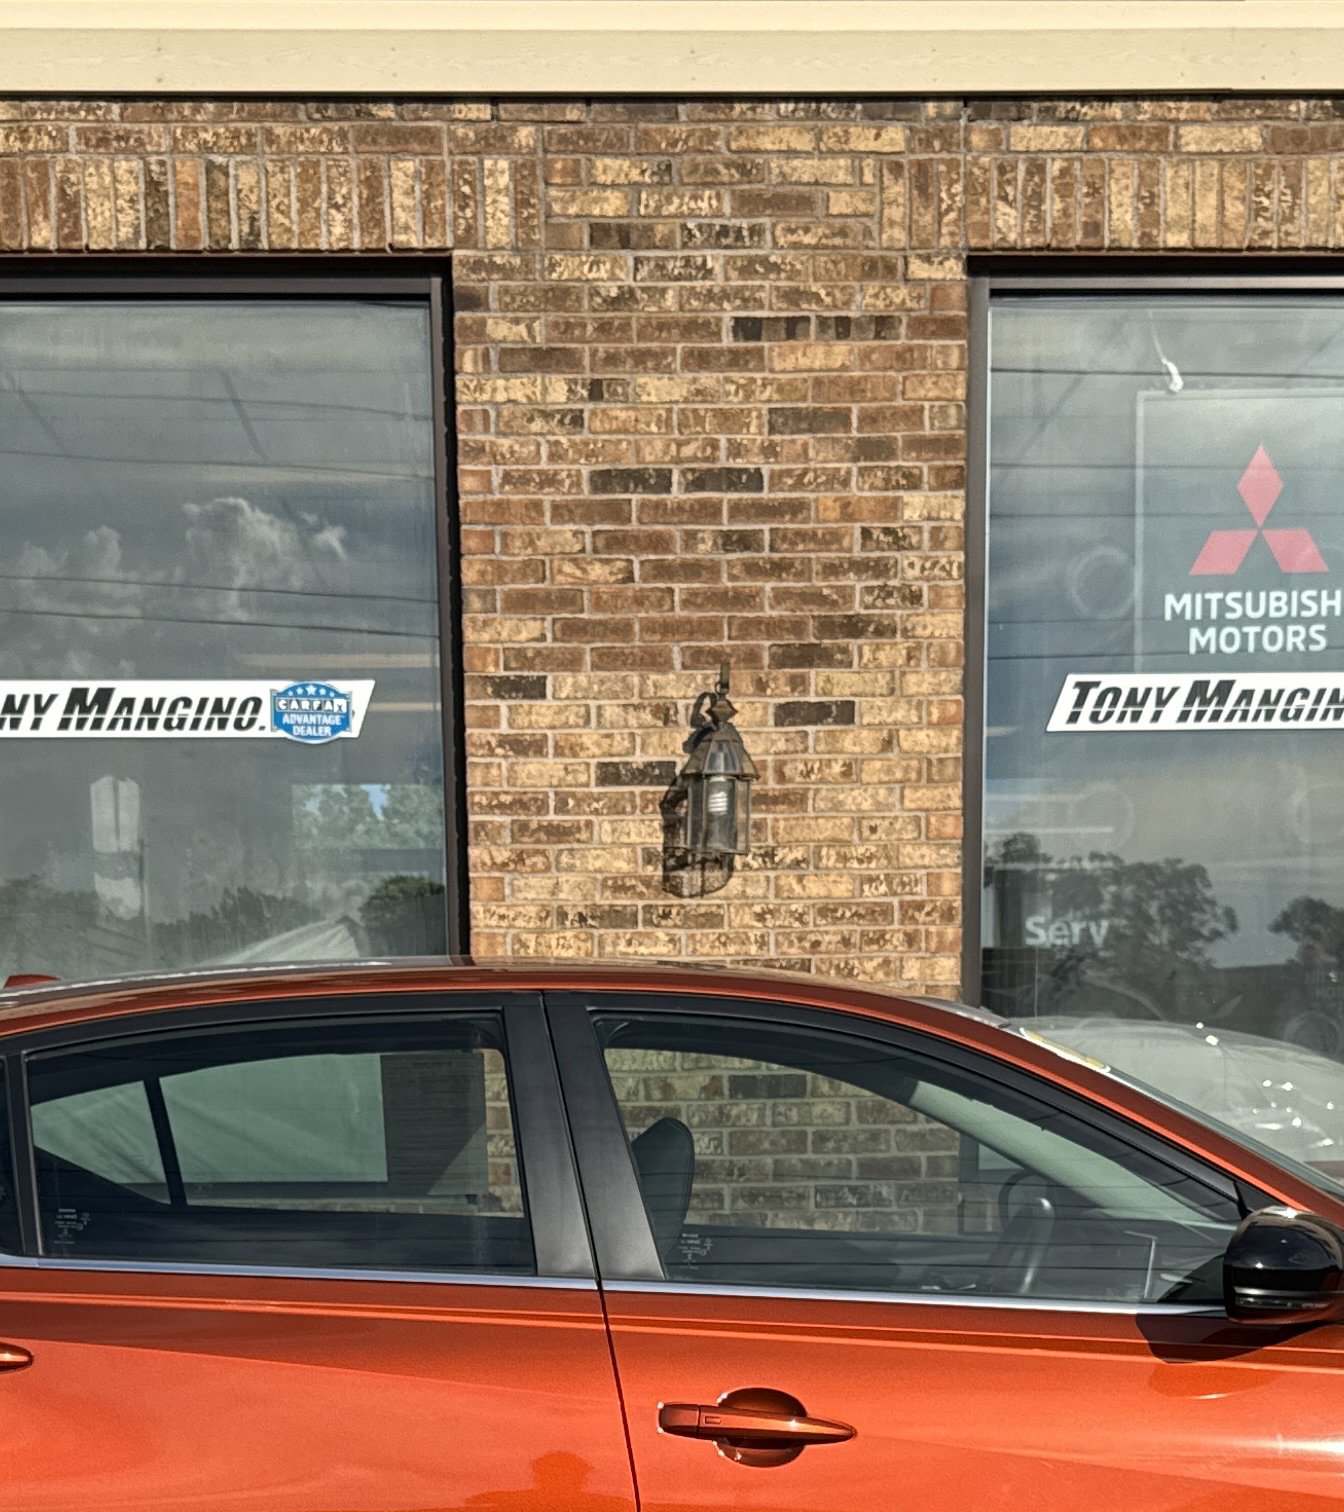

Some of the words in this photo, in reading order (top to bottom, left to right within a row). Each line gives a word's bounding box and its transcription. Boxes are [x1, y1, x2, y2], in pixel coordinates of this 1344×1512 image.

[1188, 623, 1327, 655] MOTORS
[277, 698, 347, 713] CARFAX
[1065, 680, 1181, 724] TONY
[282, 714, 342, 725] ADVANTAGE
[292, 726, 332, 737] DEALER
